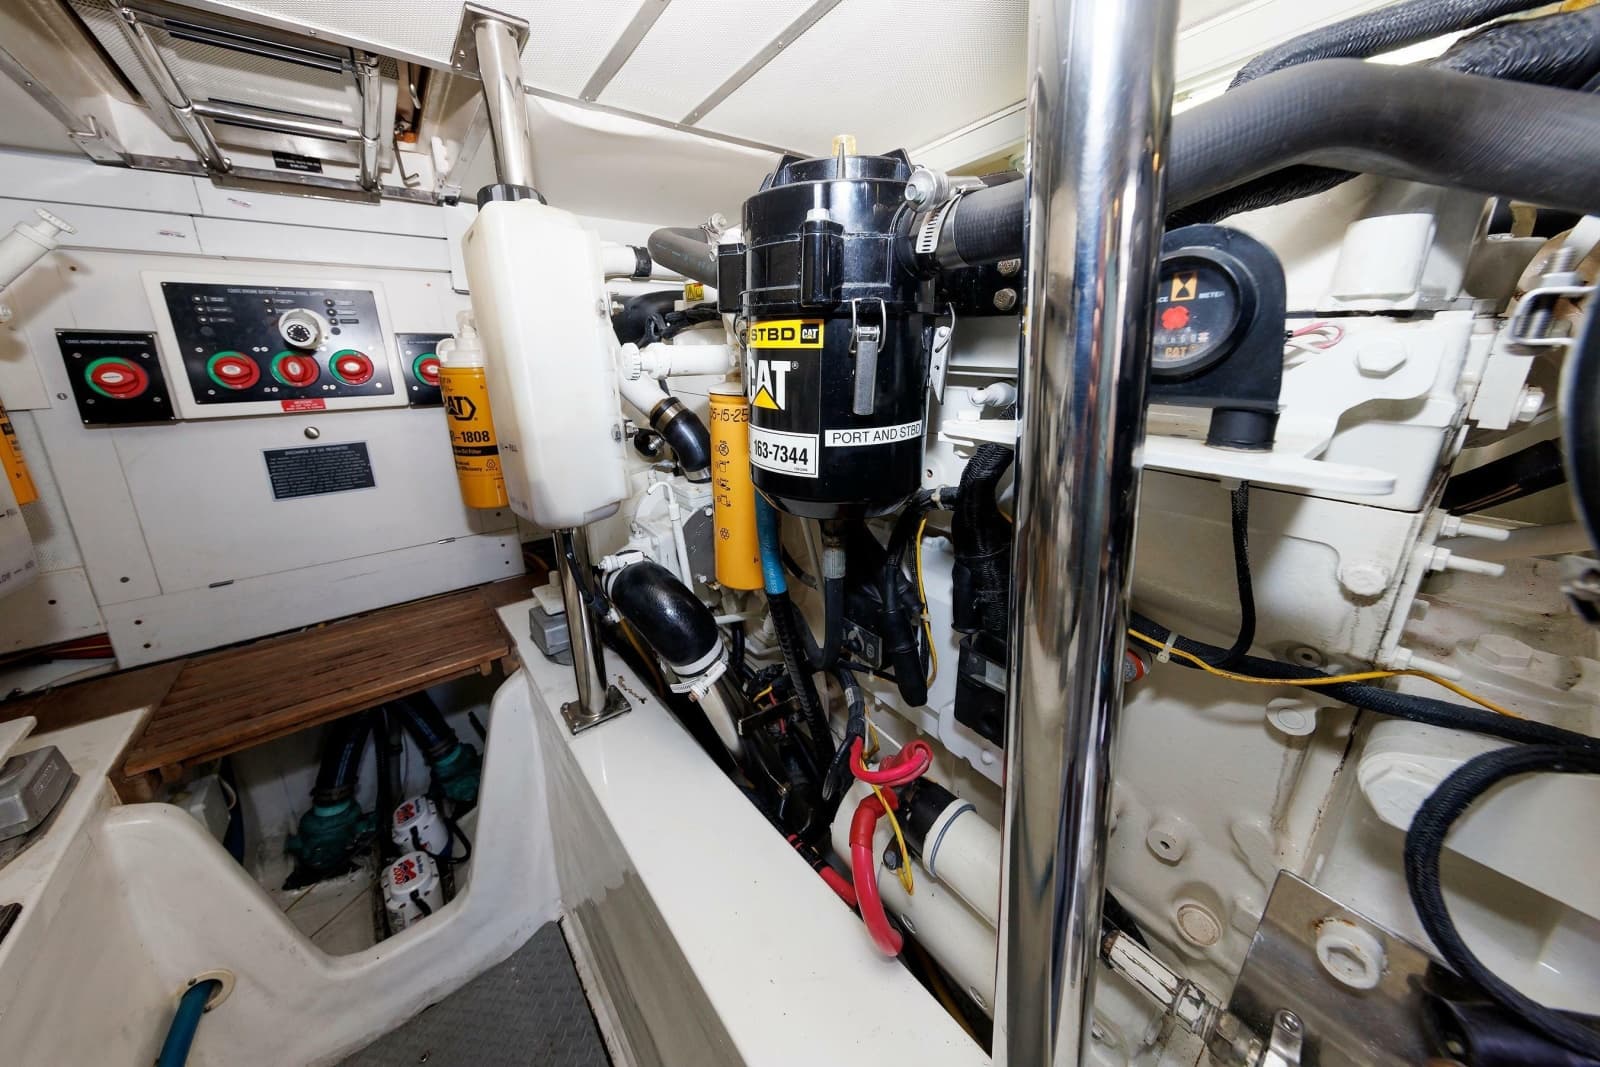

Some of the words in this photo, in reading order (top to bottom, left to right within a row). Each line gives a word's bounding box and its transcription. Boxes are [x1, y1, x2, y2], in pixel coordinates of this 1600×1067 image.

[751, 327, 795, 341] STBD
[801, 328, 819, 339] CAT
[832, 430, 870, 445] PORT
[873, 428, 898, 442] AND
[901, 423, 921, 438] STBD
[754, 439, 808, 465] 163-7344
